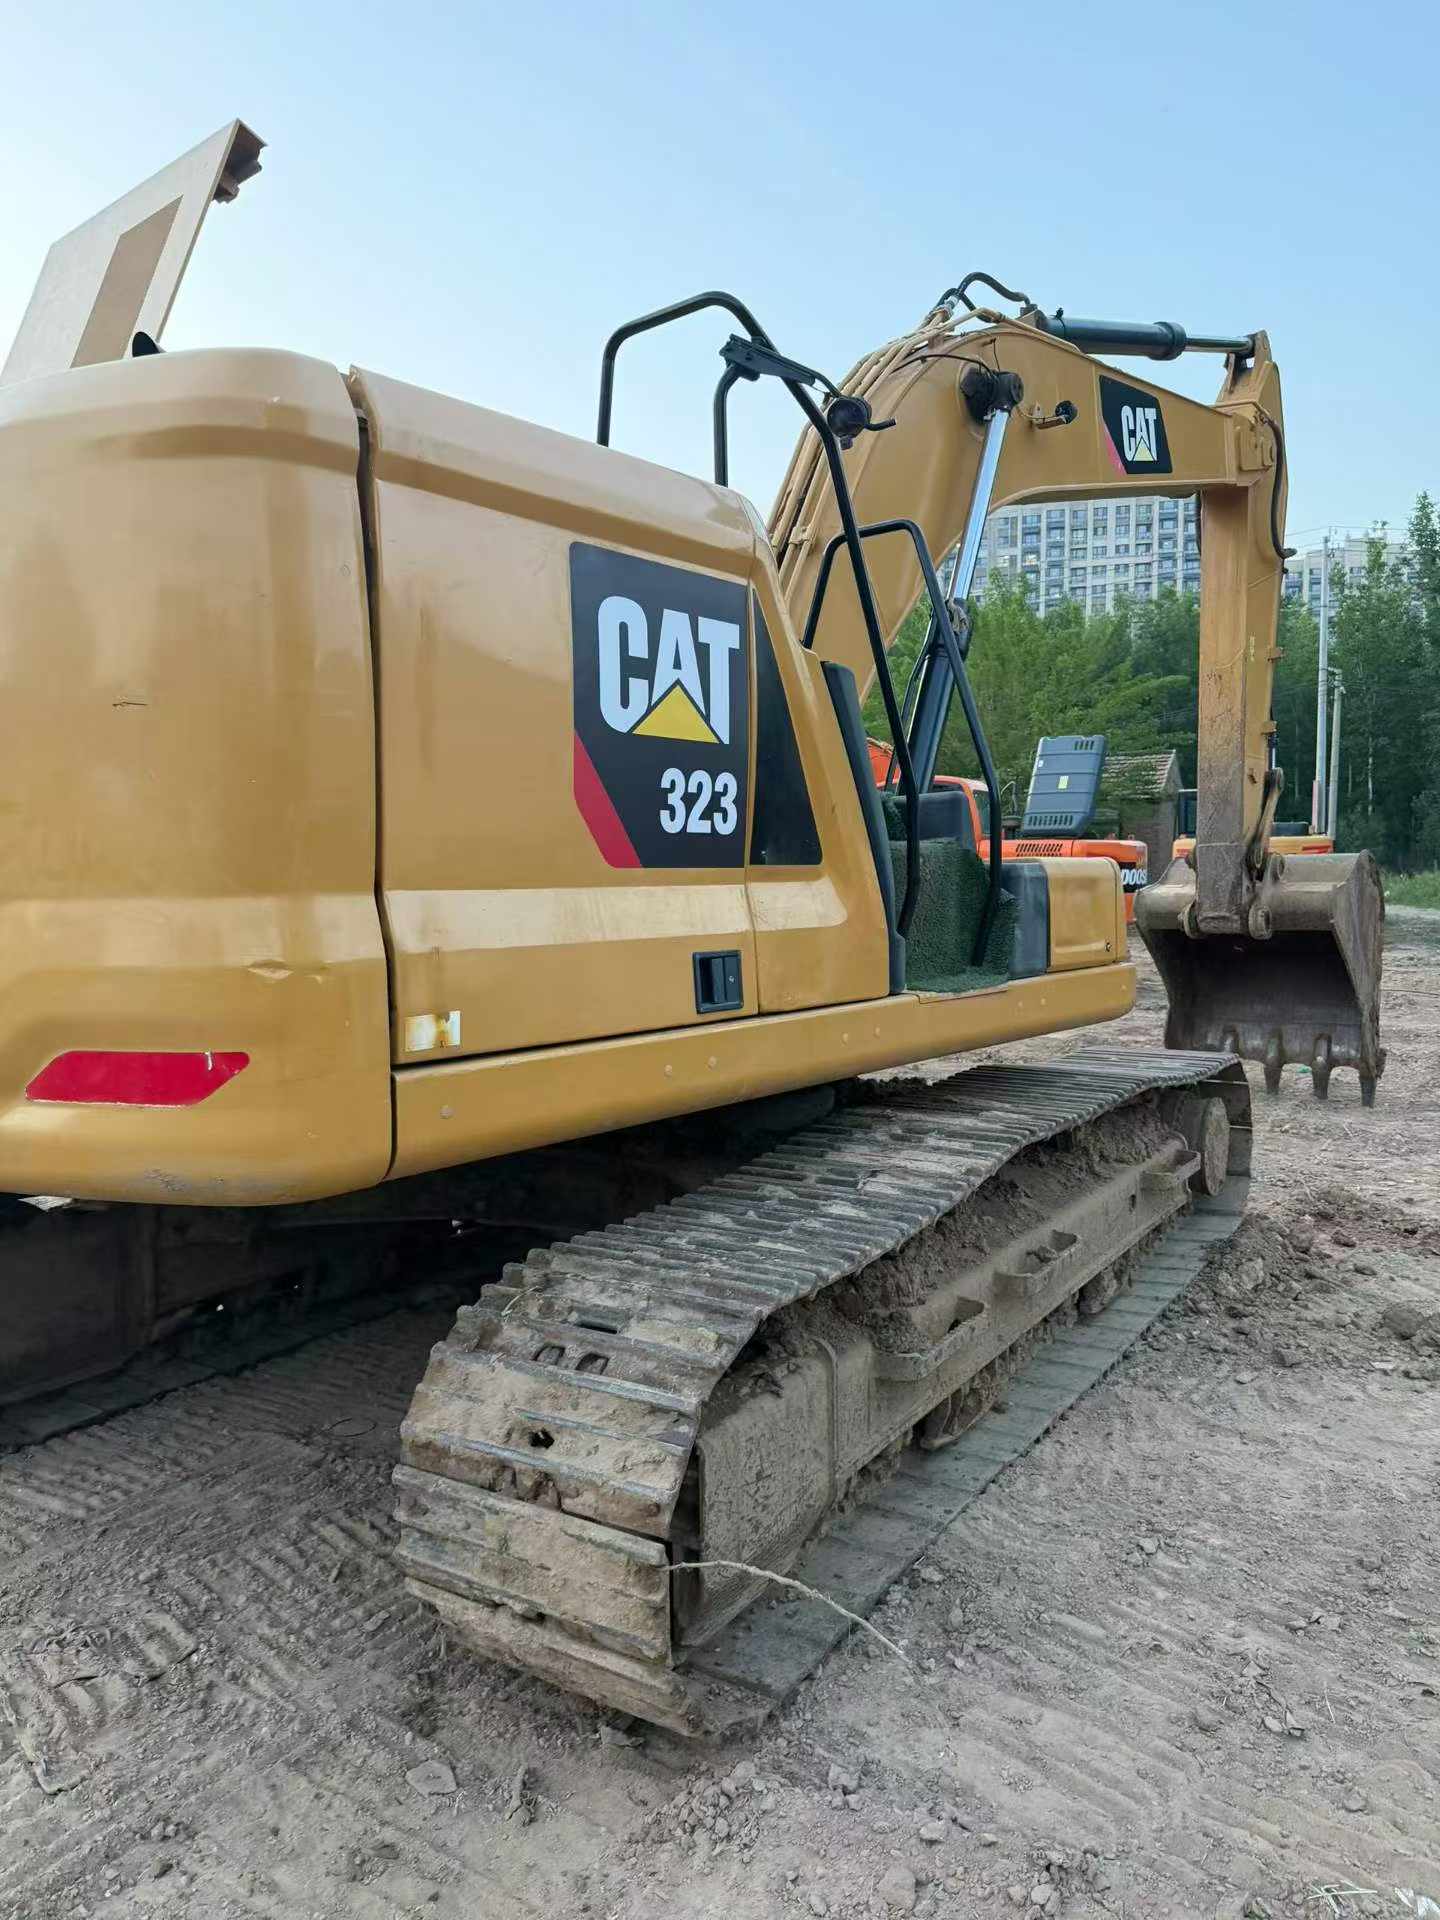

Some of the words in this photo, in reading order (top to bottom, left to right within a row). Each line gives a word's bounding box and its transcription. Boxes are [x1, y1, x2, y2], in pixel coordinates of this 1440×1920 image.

[1121, 405, 1158, 461] CAT
[598, 595, 740, 745] CAT
[659, 767, 738, 835] 323
